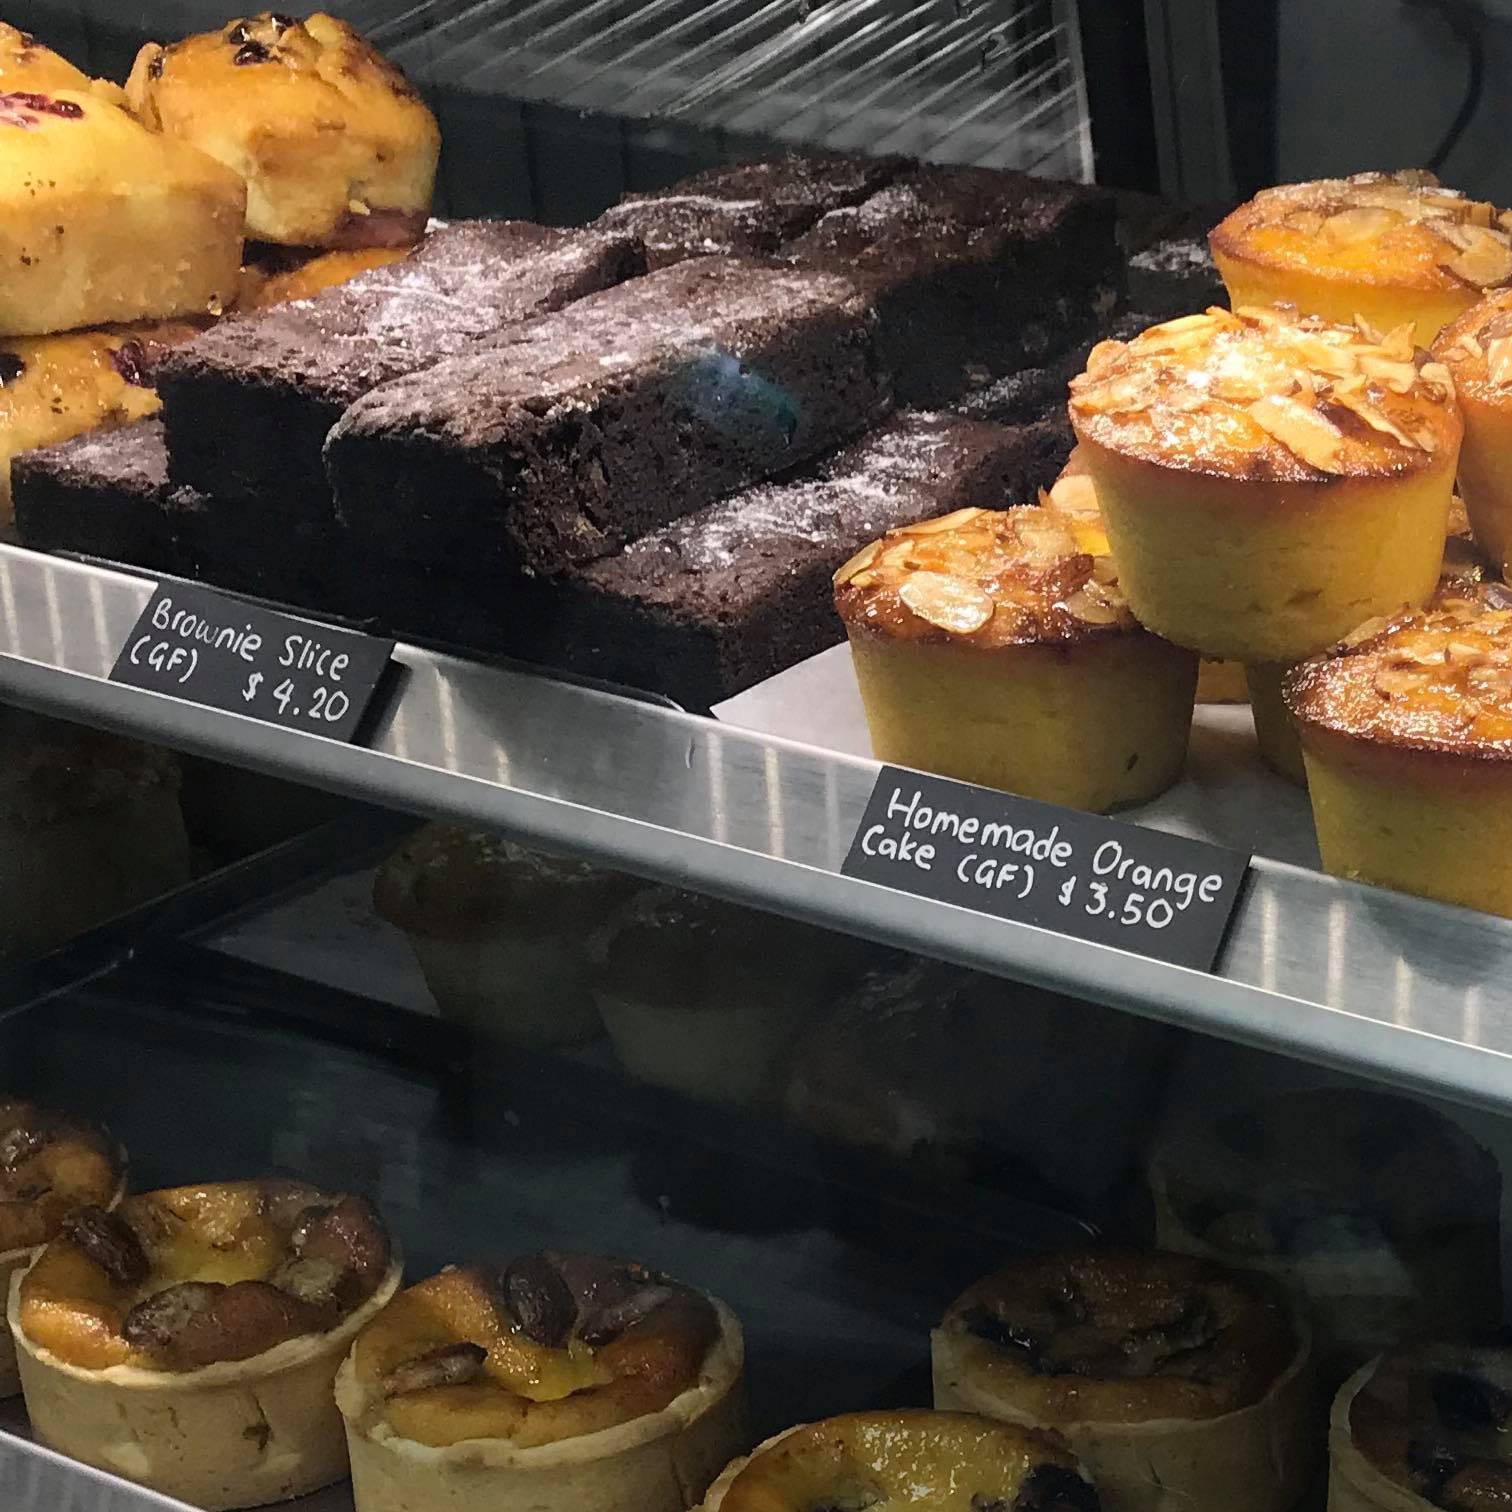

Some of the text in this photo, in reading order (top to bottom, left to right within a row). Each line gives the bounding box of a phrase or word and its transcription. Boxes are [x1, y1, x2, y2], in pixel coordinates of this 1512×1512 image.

[130, 635, 198, 683] (GF)
[152, 598, 350, 681] Brownie Slice
[861, 825, 936, 871] Cake
[887, 788, 1223, 911] Homemade Orange
